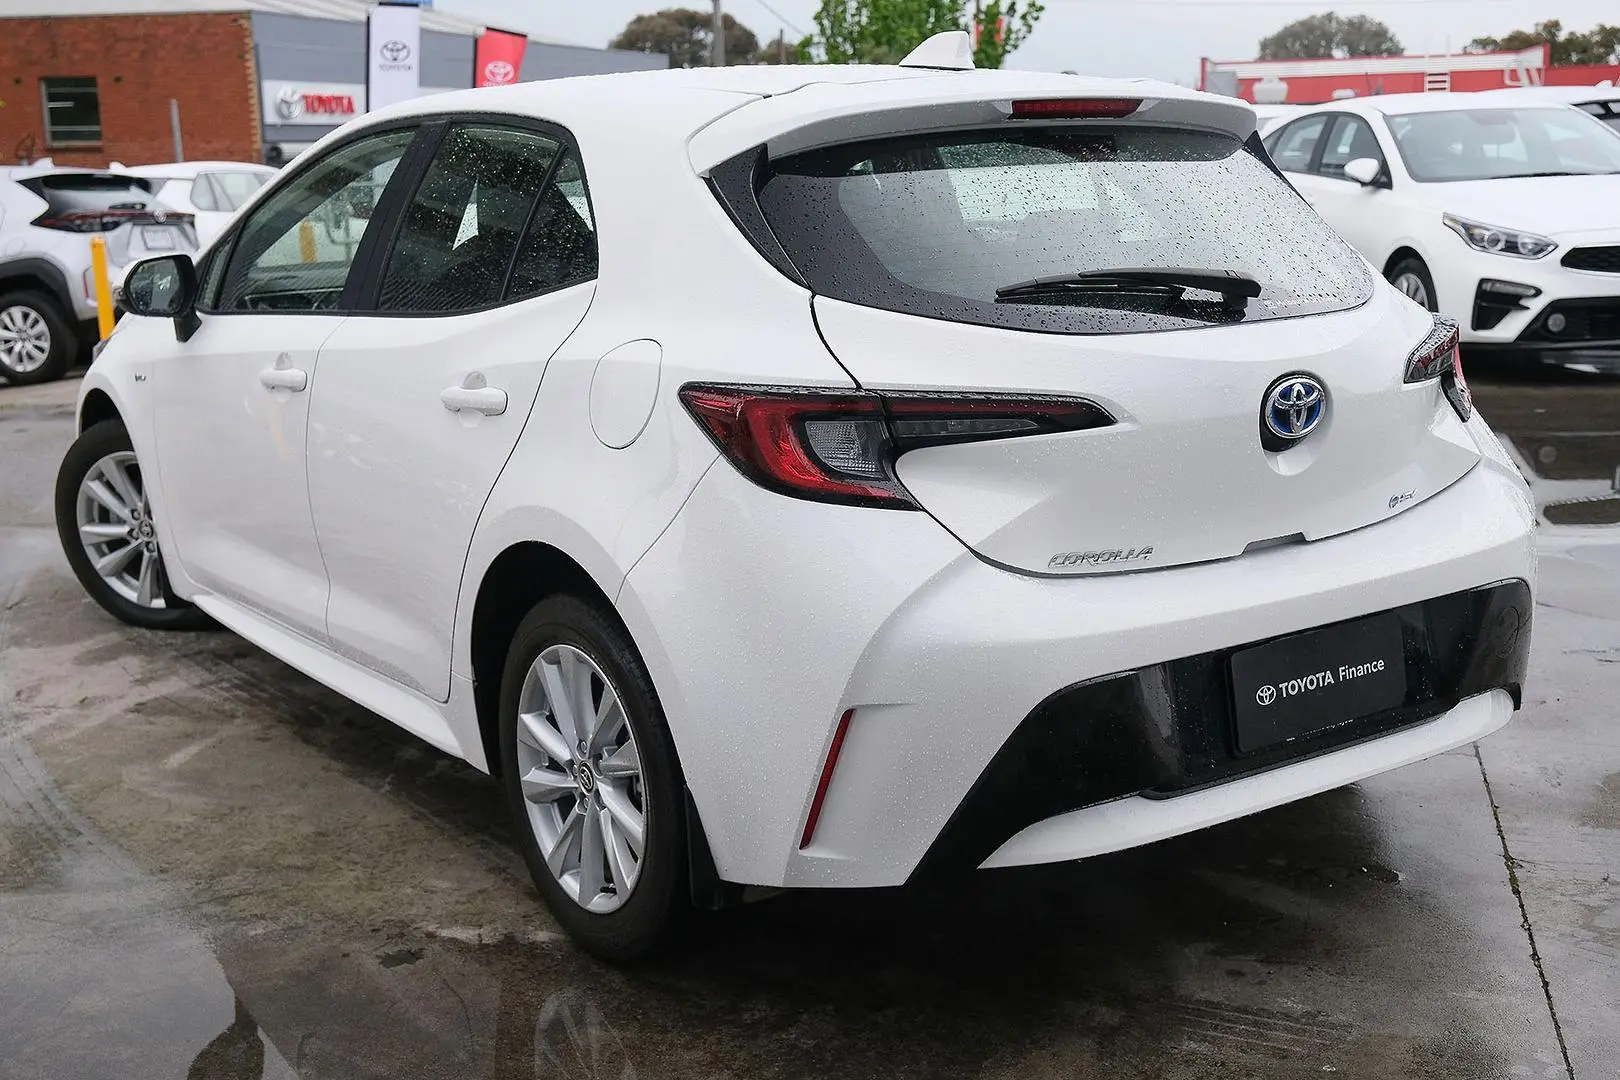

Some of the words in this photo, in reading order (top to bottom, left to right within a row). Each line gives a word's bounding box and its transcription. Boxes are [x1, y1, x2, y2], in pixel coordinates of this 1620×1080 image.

[302, 94, 354, 113] TOYOTA
[1047, 545, 1154, 567] COROLLA
[1279, 670, 1335, 698] TOYOTA
[1339, 659, 1385, 681] Finance
